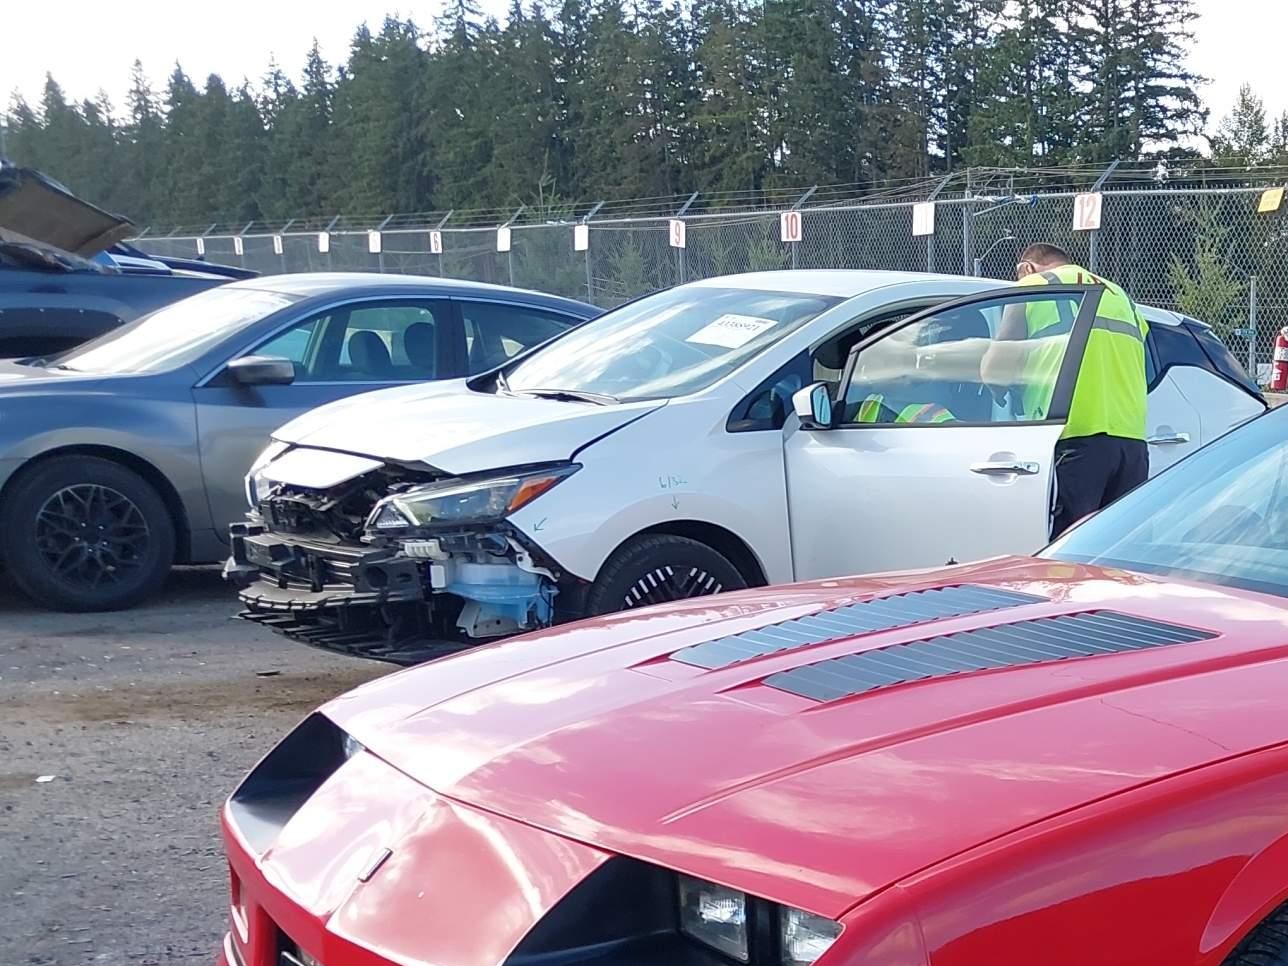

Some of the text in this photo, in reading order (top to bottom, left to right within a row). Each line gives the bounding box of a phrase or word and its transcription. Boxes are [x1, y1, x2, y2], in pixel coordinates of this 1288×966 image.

[1079, 195, 1097, 228] 12
[674, 221, 681, 246] 9
[785, 213, 798, 240] 10
[433, 233, 440, 251] 6
